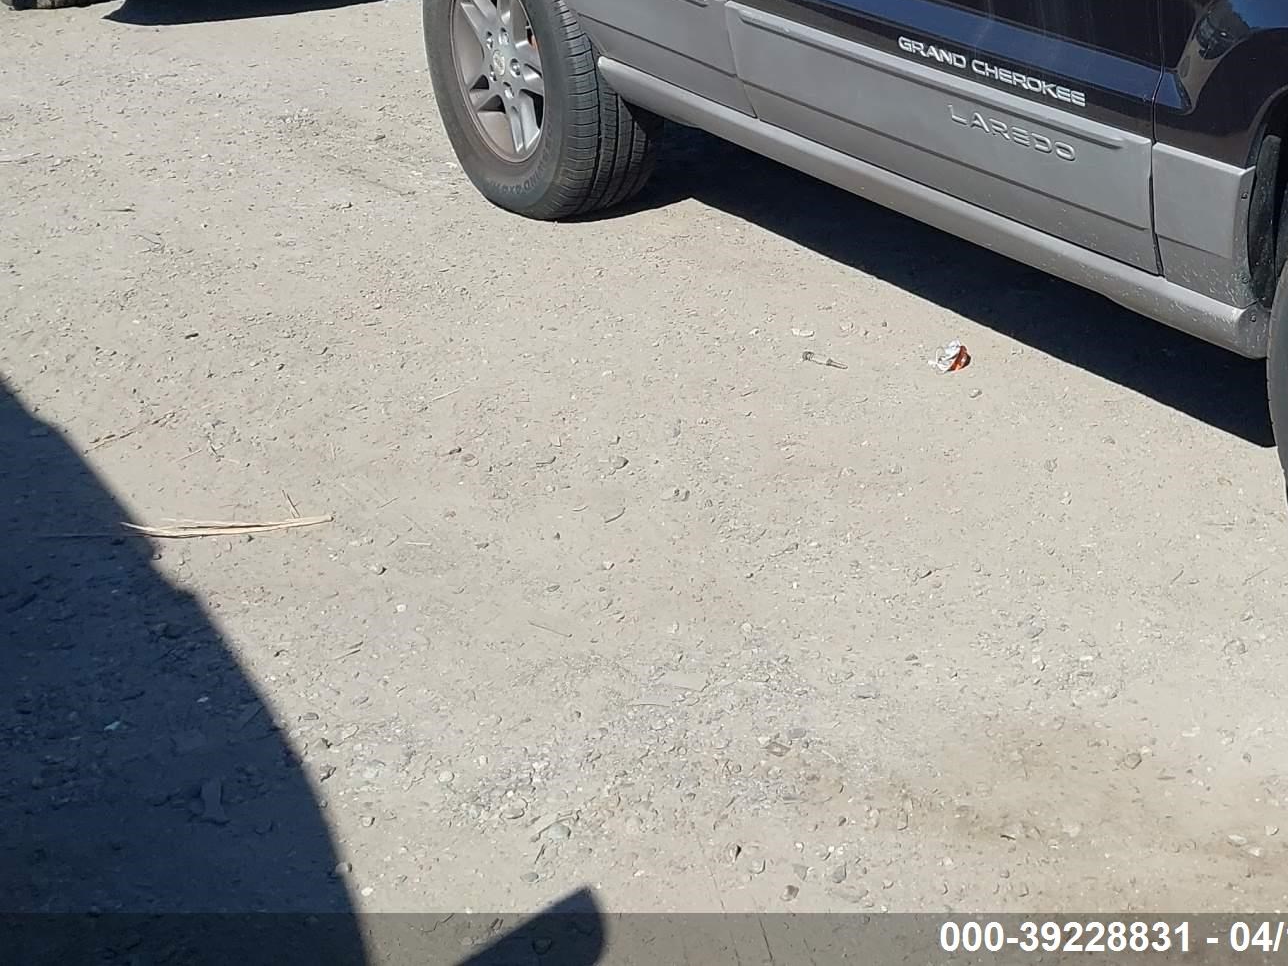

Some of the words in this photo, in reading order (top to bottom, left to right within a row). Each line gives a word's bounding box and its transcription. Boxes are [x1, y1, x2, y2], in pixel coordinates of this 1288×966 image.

[898, 36, 967, 68] GRAND
[972, 59, 1086, 107] CHEROKEE
[947, 104, 1076, 161] LAREDO
